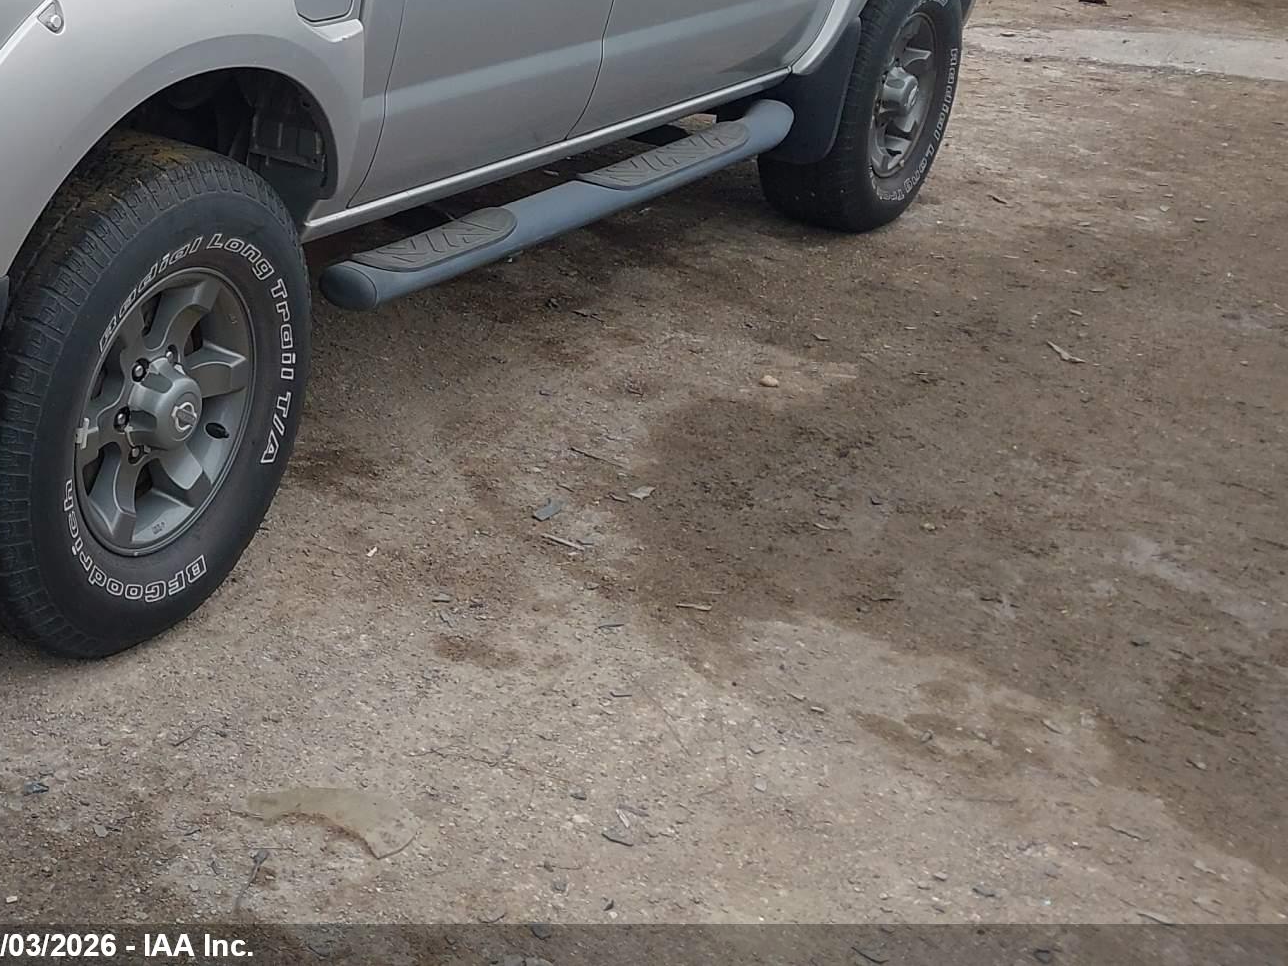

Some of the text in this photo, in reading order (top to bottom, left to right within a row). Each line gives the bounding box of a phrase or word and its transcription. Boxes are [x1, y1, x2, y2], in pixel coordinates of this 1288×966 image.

[99, 233, 297, 465] Radial Long Trail T/A
[62, 478, 208, 603] BFGoodrich
